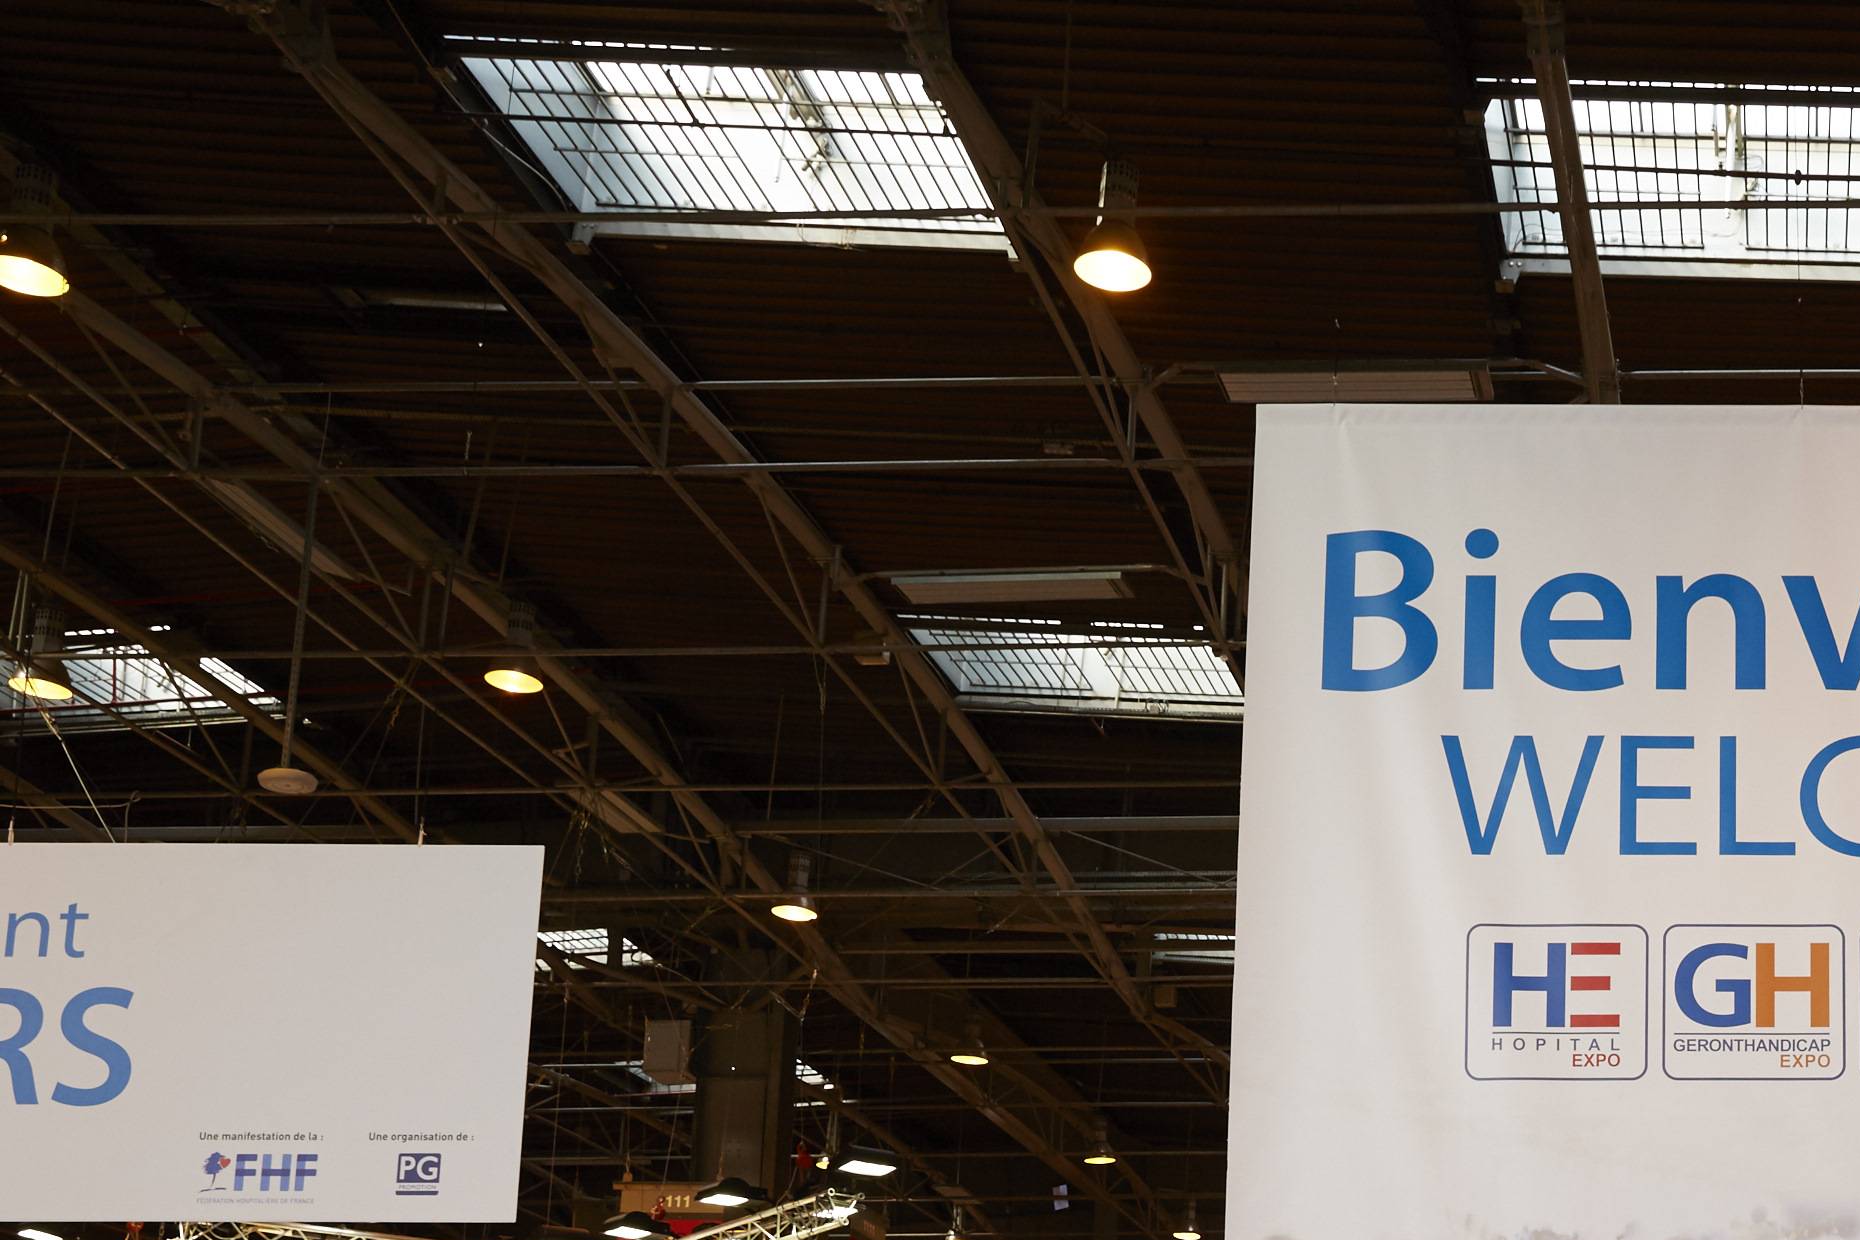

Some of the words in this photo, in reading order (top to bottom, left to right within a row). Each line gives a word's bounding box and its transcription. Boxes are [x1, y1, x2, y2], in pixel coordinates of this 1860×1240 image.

[4, 903, 89, 958] nt
[1492, 942, 1621, 1028] HE
[1673, 942, 1830, 1028] GH
[1491, 1037, 1621, 1052] HOPITAL
[1673, 1037, 1831, 1053] GERONTHANDICAP
[1571, 1053, 1621, 1068] EXPO
[1779, 1054, 1831, 1068] EXPO
[199, 1132, 219, 1141] Une
[221, 1132, 291, 1141] manifestation
[293, 1132, 305, 1141] de
[308, 1132, 318, 1141] la
[368, 1132, 388, 1141] Une
[391, 1132, 453, 1143] organisation
[456, 1132, 468, 1141] de
[233, 1154, 319, 1191] FHF
[399, 1156, 438, 1181] PG
